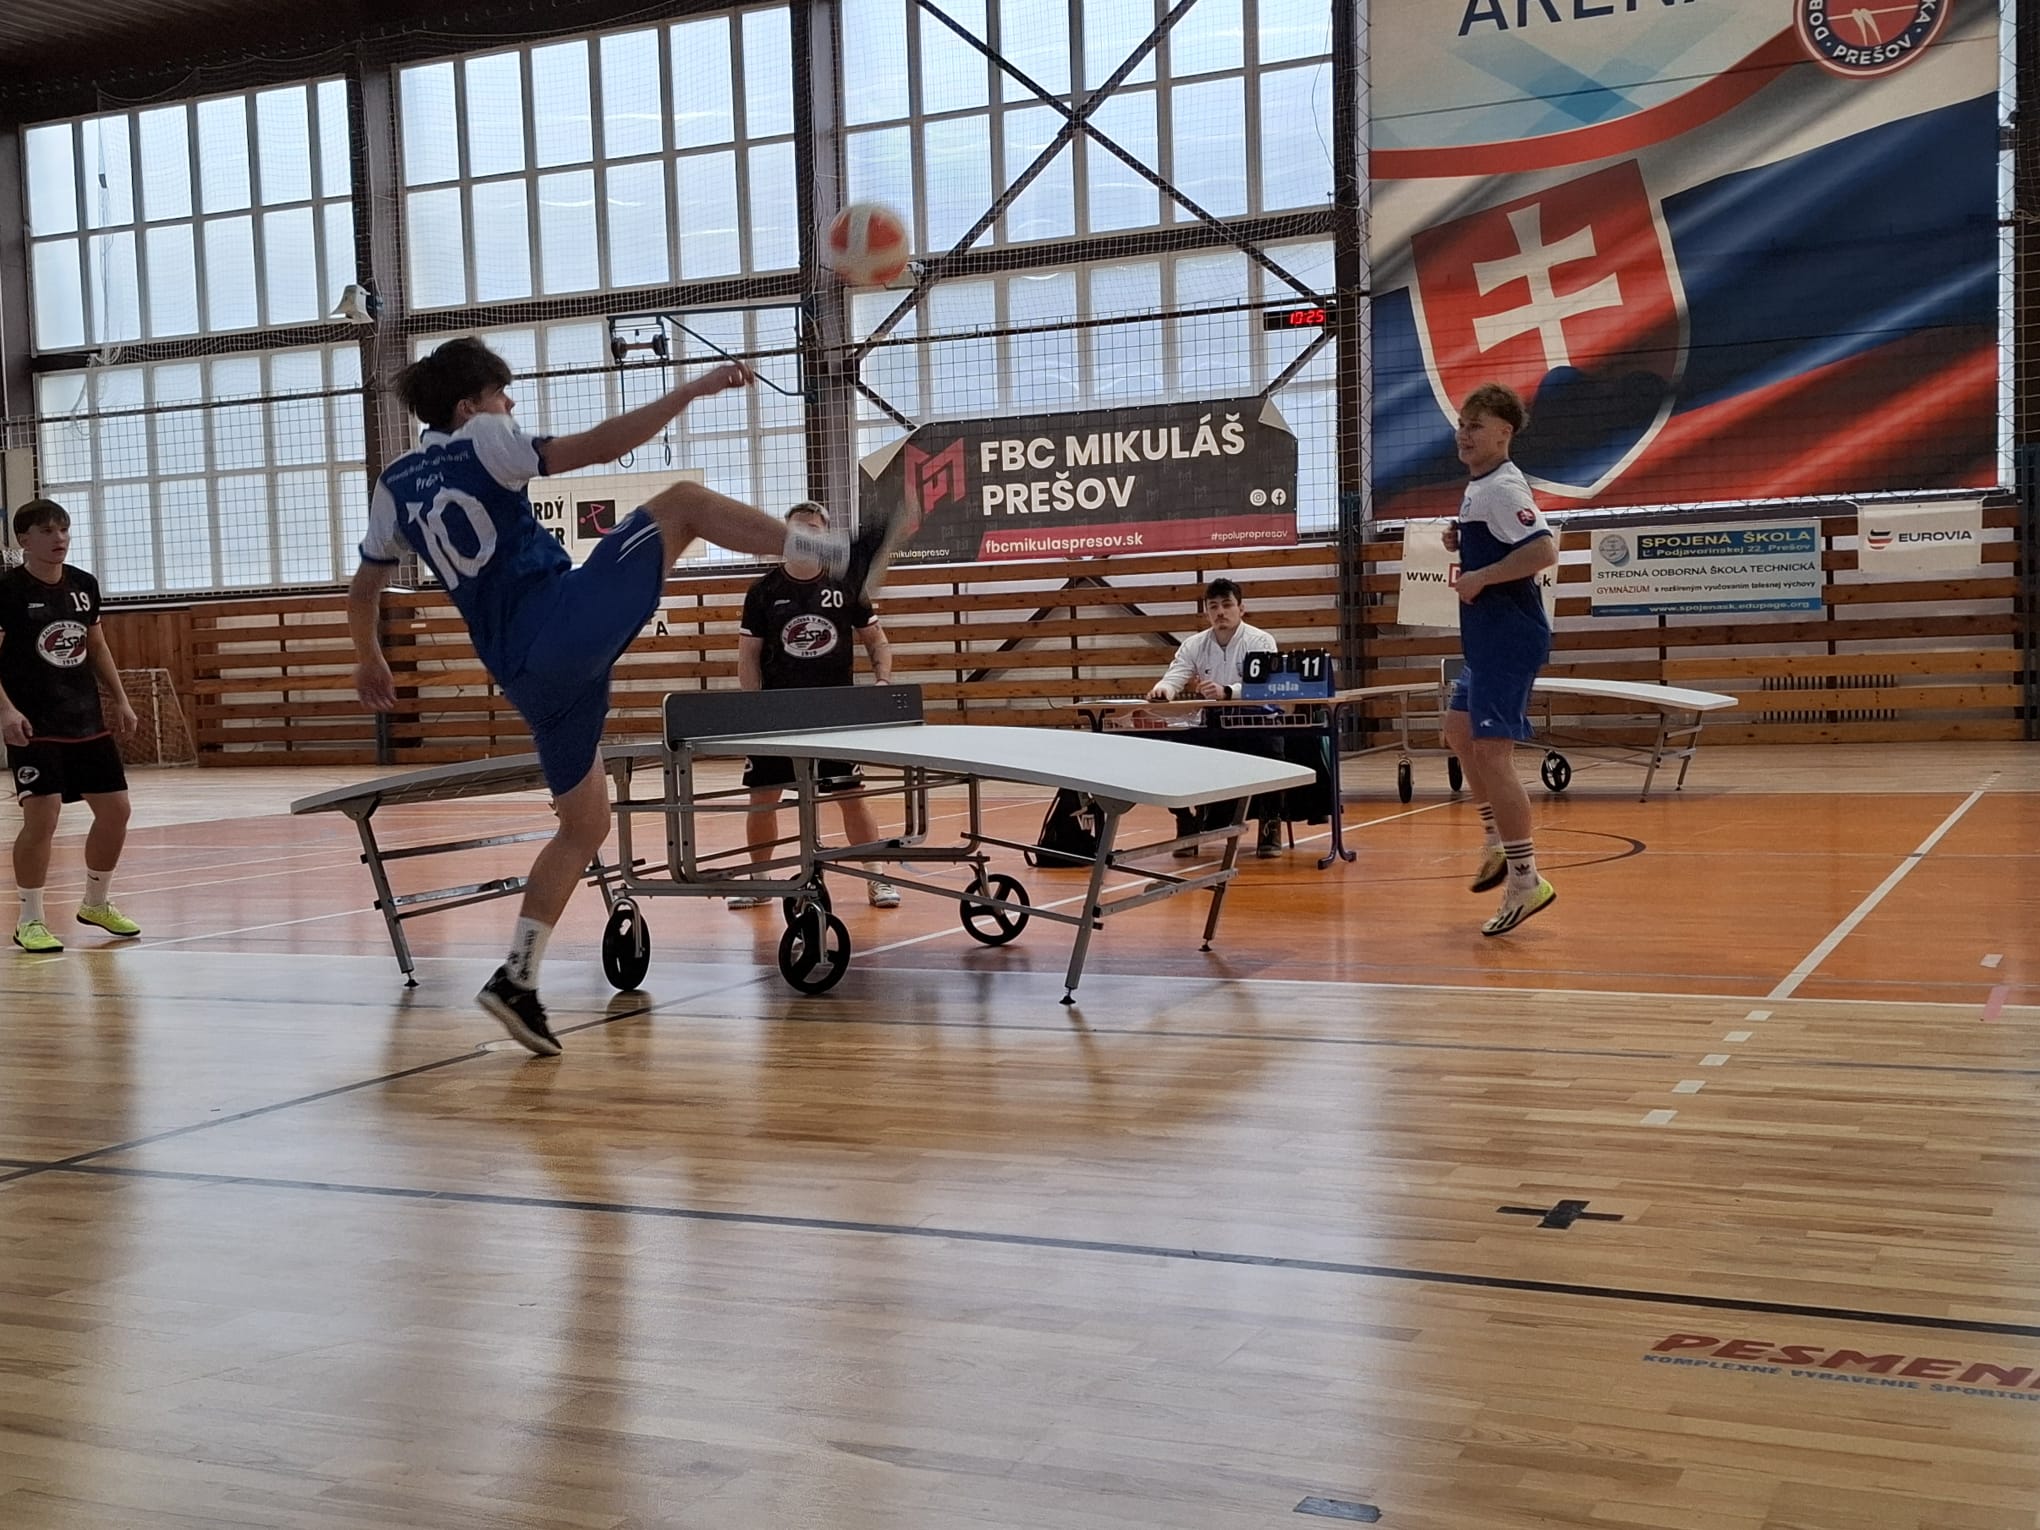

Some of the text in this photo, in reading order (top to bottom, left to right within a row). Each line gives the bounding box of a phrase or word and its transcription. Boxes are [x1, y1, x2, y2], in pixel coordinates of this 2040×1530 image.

[1808, 0, 1830, 41] DOB
[1833, 34, 1912, 65] PREŠOV
[980, 411, 1246, 473] FBC MIKULÁŠ
[981, 470, 1136, 517] PREŠOV
[533, 495, 564, 521] RDÝ
[405, 485, 498, 592] 10
[984, 532, 1144, 555] fbcmikulaspresov.sk
[1210, 529, 1288, 542] #spolupropresov
[1641, 533, 1732, 549] SPOJENÁ
[1743, 530, 1811, 544] ŠKOLA
[1898, 530, 1972, 543] EUROVIA
[888, 548, 950, 559] mikulaspresov
[1656, 546, 1744, 557] Podjavorinskej
[1597, 561, 1816, 580] STREDNÁ ODBORNÁ ŠKOLA TECHNICKÁ
[821, 588, 844, 608] 20
[1596, 584, 1650, 595] GYMNÁZIUM
[69, 591, 91, 613] 19
[1249, 658, 1261, 678] 6
[1301, 657, 1321, 677] 11
[1267, 681, 1300, 695] gala
